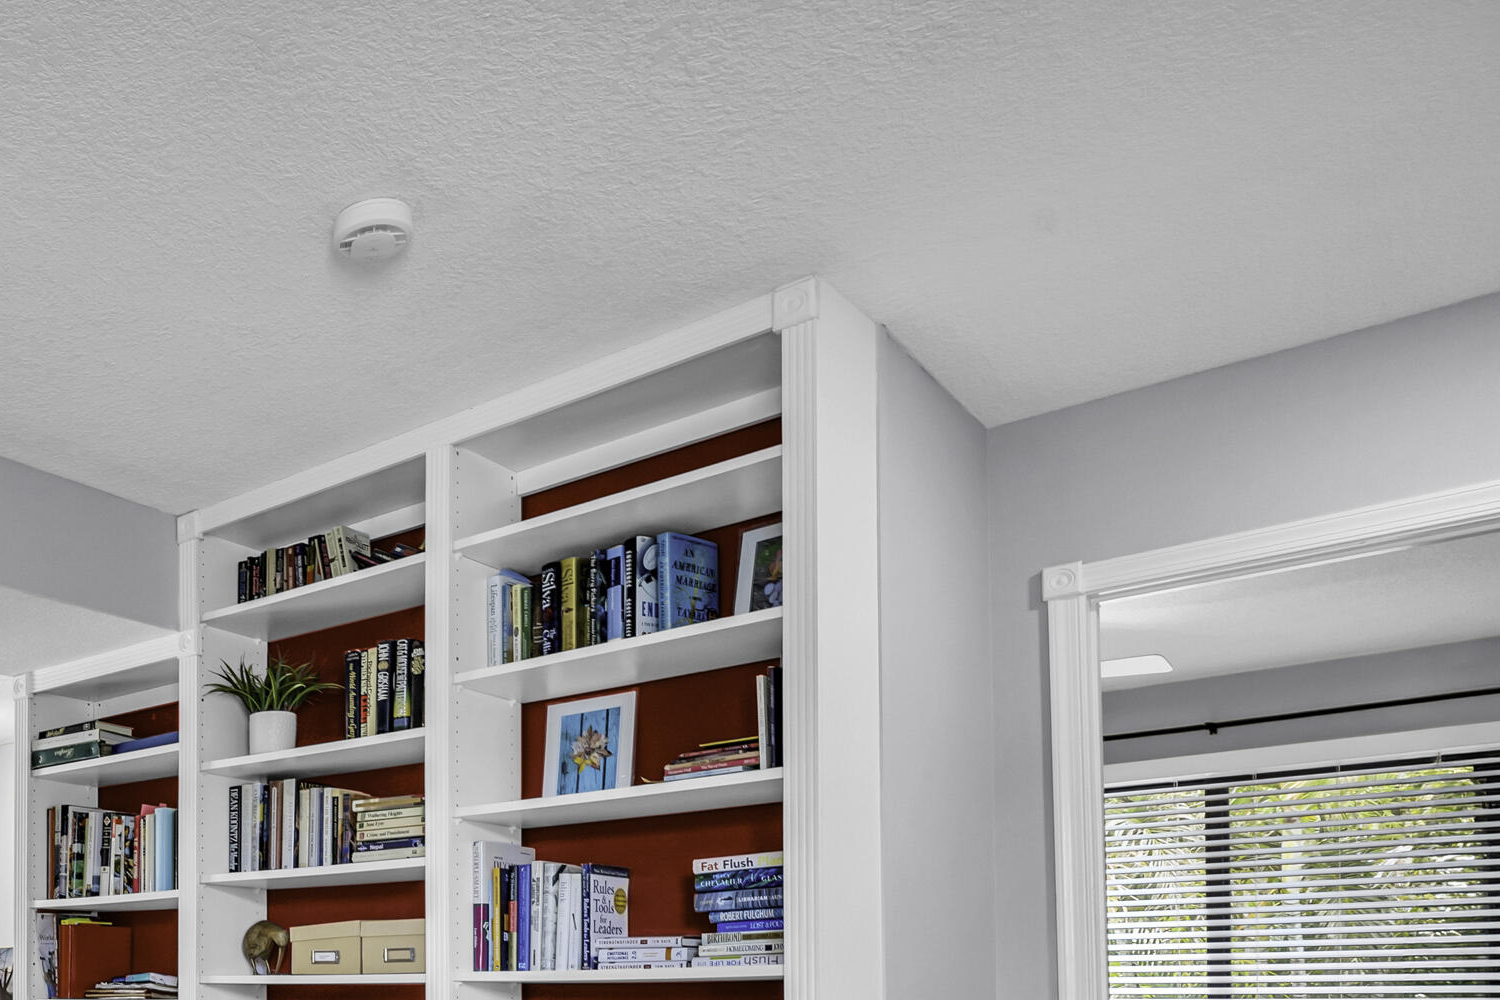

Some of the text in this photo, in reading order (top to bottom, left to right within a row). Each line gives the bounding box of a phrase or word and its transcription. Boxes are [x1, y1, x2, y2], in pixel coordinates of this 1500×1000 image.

[684, 548, 694, 557] AN
[672, 560, 715, 578] AMERICAN
[542, 572, 556, 610] Silva
[562, 568, 574, 604] Silva
[489, 584, 498, 616] Lifespan
[397, 640, 408, 650] CAT
[378, 643, 389, 701] JOHN GRISHAM
[397, 656, 407, 676] MOUSE
[349, 671, 357, 689] World
[348, 690, 357, 718] According
[396, 681, 407, 716] PATTERSON
[229, 788, 239, 811] DEAN
[229, 811, 239, 843] KOONTZ
[701, 858, 753, 871] Fat Flush
[593, 880, 614, 895] Rules
[700, 878, 742, 888] CHEVALIER
[593, 899, 614, 914] Tools
[720, 910, 774, 922] ROBERT FULGHUM
[593, 920, 623, 936] Leaders
[744, 956, 779, 966] Flush
